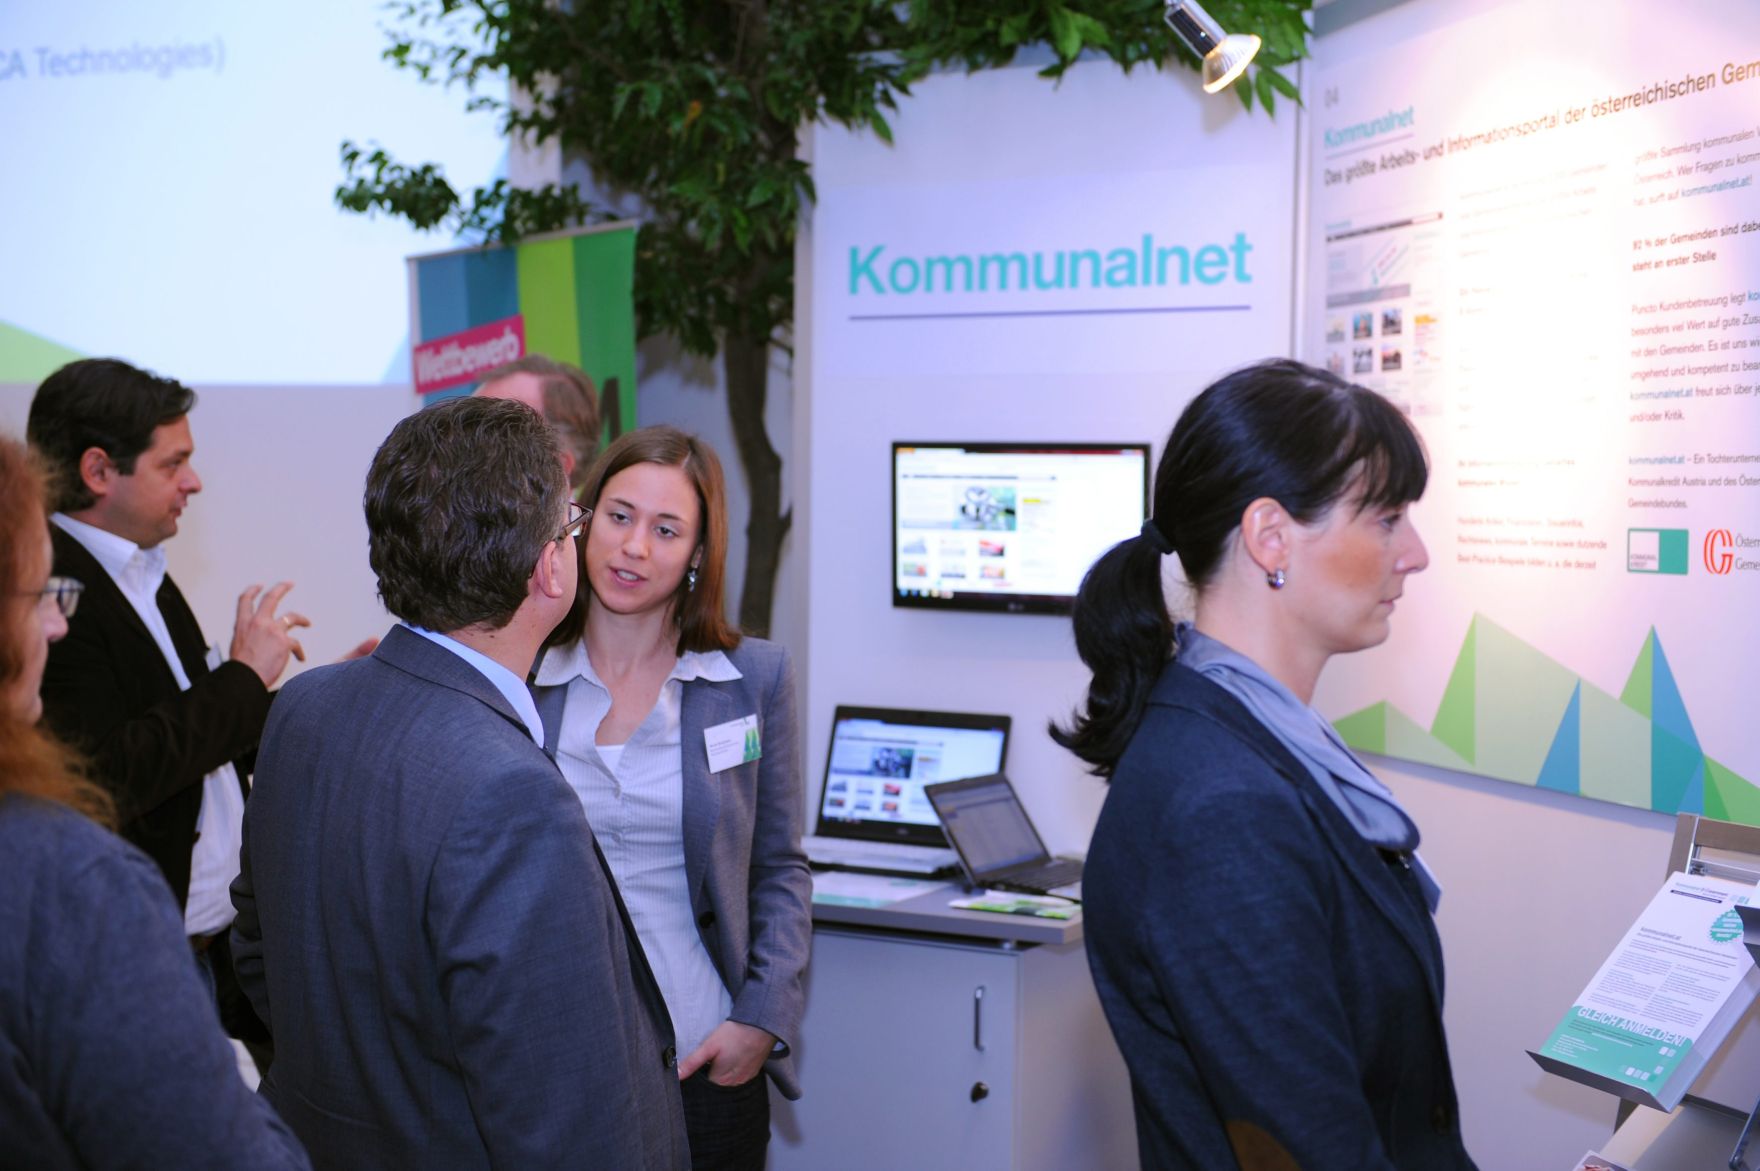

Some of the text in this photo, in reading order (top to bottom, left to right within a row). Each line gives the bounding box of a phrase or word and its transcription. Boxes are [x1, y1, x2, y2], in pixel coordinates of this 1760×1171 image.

[34, 35, 225, 79] Technologies)
[1324, 61, 1760, 187] Das größte Arbeits- und Informationsportal der österreichischen Gem
[1324, 106, 1414, 148] Kommunalnet
[1660, 142, 1701, 158] Sammlung
[1677, 165, 1693, 176] Wer
[1695, 159, 1723, 174] Fragen
[1725, 158, 1735, 167] zu
[1654, 237, 1667, 247] der
[1670, 228, 1718, 245] Gemeinden
[1720, 224, 1739, 237] sind
[848, 231, 1253, 296] Kommunalnet
[1632, 251, 1717, 272] steht an erster Stelle
[1631, 304, 1658, 315] Puncto
[1659, 296, 1728, 312] Kundenbetreuung
[1730, 292, 1746, 306] legt
[1631, 325, 1669, 337] besonders
[1686, 319, 1706, 331] Wert
[1707, 317, 1721, 329] auf
[1722, 318, 1741, 331] gute
[418, 326, 521, 386] Wettbewerb
[1643, 348, 1658, 358] den
[1659, 344, 1706, 357] Gemeinden.
[1708, 340, 1719, 352] Es
[1720, 340, 1731, 351] ist
[1732, 340, 1748, 350] uns
[1631, 367, 1669, 382] umgehend
[1671, 366, 1686, 377] und
[1687, 362, 1729, 377] kompetent
[1731, 363, 1741, 373] zu
[1630, 387, 1694, 401] kommunalnet.at
[1695, 386, 1714, 398] freut
[1715, 384, 1732, 396] sich
[1734, 383, 1753, 396] über
[1664, 408, 1685, 421] Kritik.
[1628, 454, 1686, 465] kommunalnet.at
[1693, 452, 1706, 465] Ein
[1627, 476, 1681, 487] Kommunalkredit
[1682, 475, 1707, 487] Austria
[1707, 476, 1722, 487] und
[1723, 476, 1738, 487] des
[1627, 497, 1688, 509] Gemeindebundes.
[1577, 1006, 1621, 1029] GLEICH
